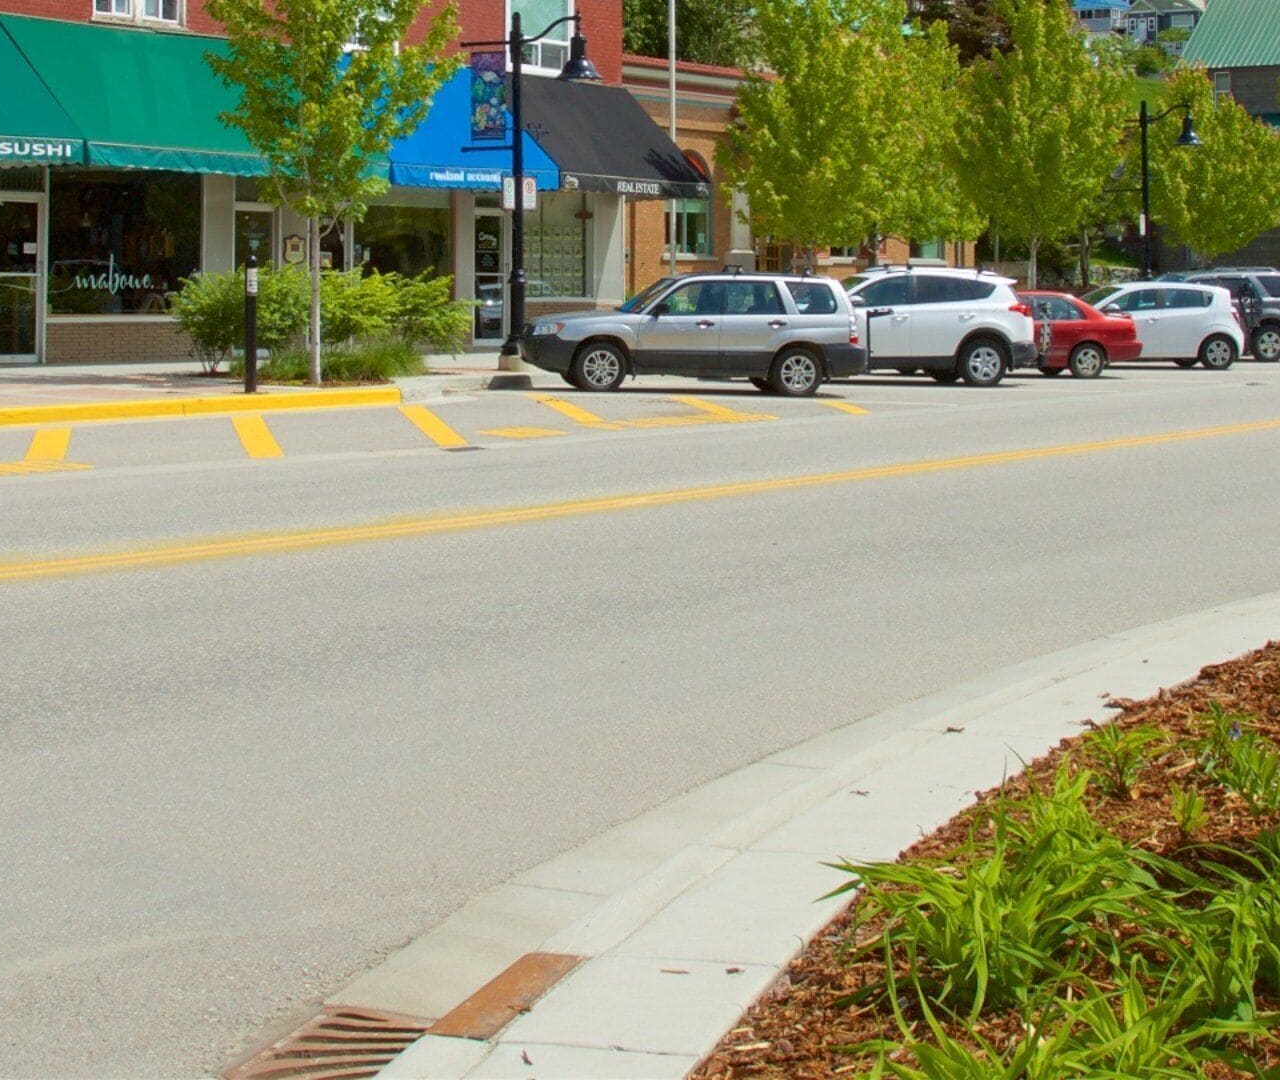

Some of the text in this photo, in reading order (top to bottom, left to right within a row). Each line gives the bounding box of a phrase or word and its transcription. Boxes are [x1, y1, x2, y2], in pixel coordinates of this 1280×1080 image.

[466, 171, 502, 183] accounti
[616, 180, 660, 194] REAL ESTATE
